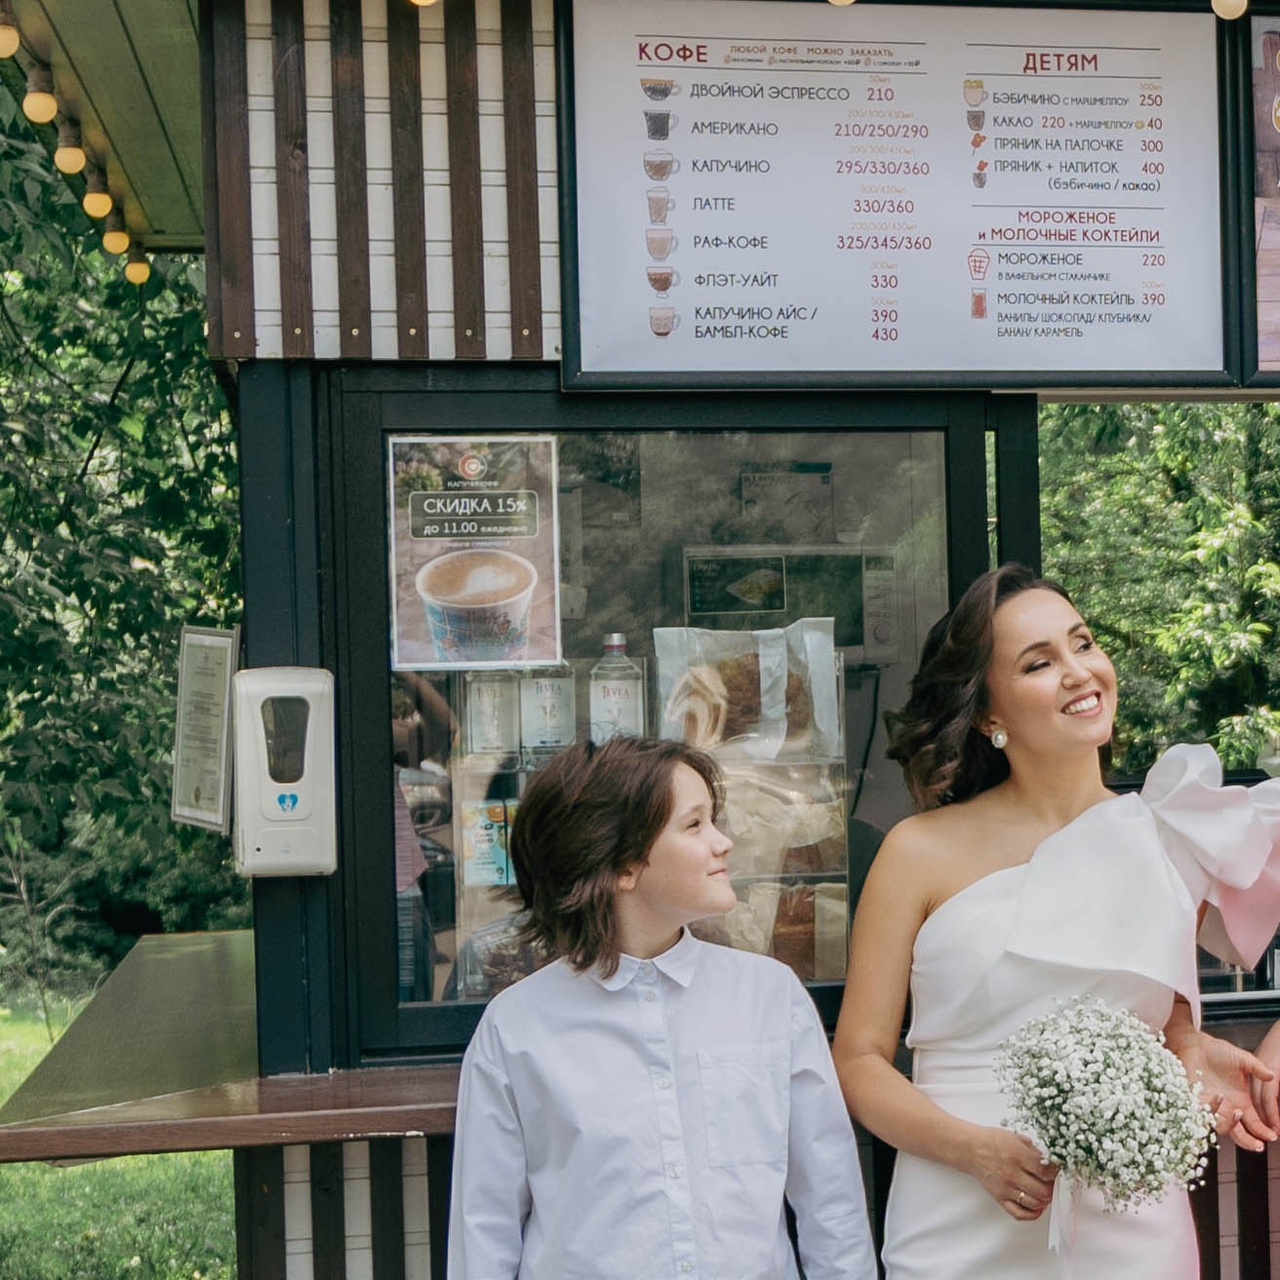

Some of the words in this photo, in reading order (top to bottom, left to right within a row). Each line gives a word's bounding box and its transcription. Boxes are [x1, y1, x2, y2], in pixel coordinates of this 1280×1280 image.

[638, 43, 708, 62] КОФЕ
[730, 44, 766, 54] ЛЮБОЙ
[772, 47, 798, 55] КОФЕ
[808, 48, 843, 56] МОЖНО
[850, 48, 893, 57] ЗАКАЗАТЬ
[1023, 53, 1098, 73] ДЕТЯМ
[690, 83, 764, 99] ДВОЙНОЙ
[769, 87, 850, 100] ЭСПРЕССО
[867, 88, 894, 101] 210
[993, 94, 1060, 105] БЭБИЧИНО
[1071, 97, 1129, 106] МАРШМЕЛЛОУ
[1140, 95, 1162, 106] 250
[692, 122, 778, 135] АМЕРИКАНО
[835, 124, 928, 138] 210/250/290
[993, 117, 1033, 127] КАКАО
[1042, 117, 1064, 128] 220
[1076, 121, 1133, 129] МАРШМЕЛЛОУ
[1147, 118, 1162, 130] 40
[994, 138, 1043, 150] ПРЯНИК
[1045, 140, 1062, 150] НА
[1064, 140, 1123, 151] ПАЛОЧКЕ
[1140, 140, 1163, 152] 300
[692, 160, 770, 172] КАПУЧИНО
[836, 161, 930, 175] 295/330/360
[994, 160, 1043, 172] ПРЯНИК
[1060, 162, 1119, 173] НАПИТОК
[1142, 163, 1164, 174] 400
[1048, 178, 1110, 190] (бэбичино
[1122, 180, 1161, 191] какао)
[692, 198, 735, 210] ЛАТТЕ
[853, 200, 914, 213] 330/360
[1018, 211, 1116, 224] МОРОЖЕНОЕ
[978, 231, 985, 240] и
[991, 228, 1077, 241] МОЛОЧНЫЕ
[1082, 228, 1160, 242] КОКТЕЙЛИ
[694, 236, 768, 249] РАФ-КОФЕ
[836, 237, 932, 250] 325/345/360
[999, 253, 1083, 265] МОРОЖЕНОЕ
[1142, 254, 1165, 266] 220
[694, 271, 778, 288] ФЛЭТ-УАЙТ
[871, 275, 898, 288] 330
[997, 291, 1069, 304] МОЛОЧНЫЙ
[1073, 292, 1135, 305] КОКТЕЙЛЬ
[1142, 294, 1165, 305] 390
[695, 307, 772, 320] КАПУЧИНО
[777, 305, 807, 320] АЙС
[872, 310, 898, 322] 390
[695, 326, 788, 339] БАМБЛ-КОФЕ
[872, 328, 898, 341] 430
[1034, 328, 1083, 337] КАРАМЕЛЬ
[423, 498, 492, 515] СКИДКА
[497, 498, 526, 513] 15%
[423, 525, 438, 535] до
[444, 523, 477, 533] 11.00
